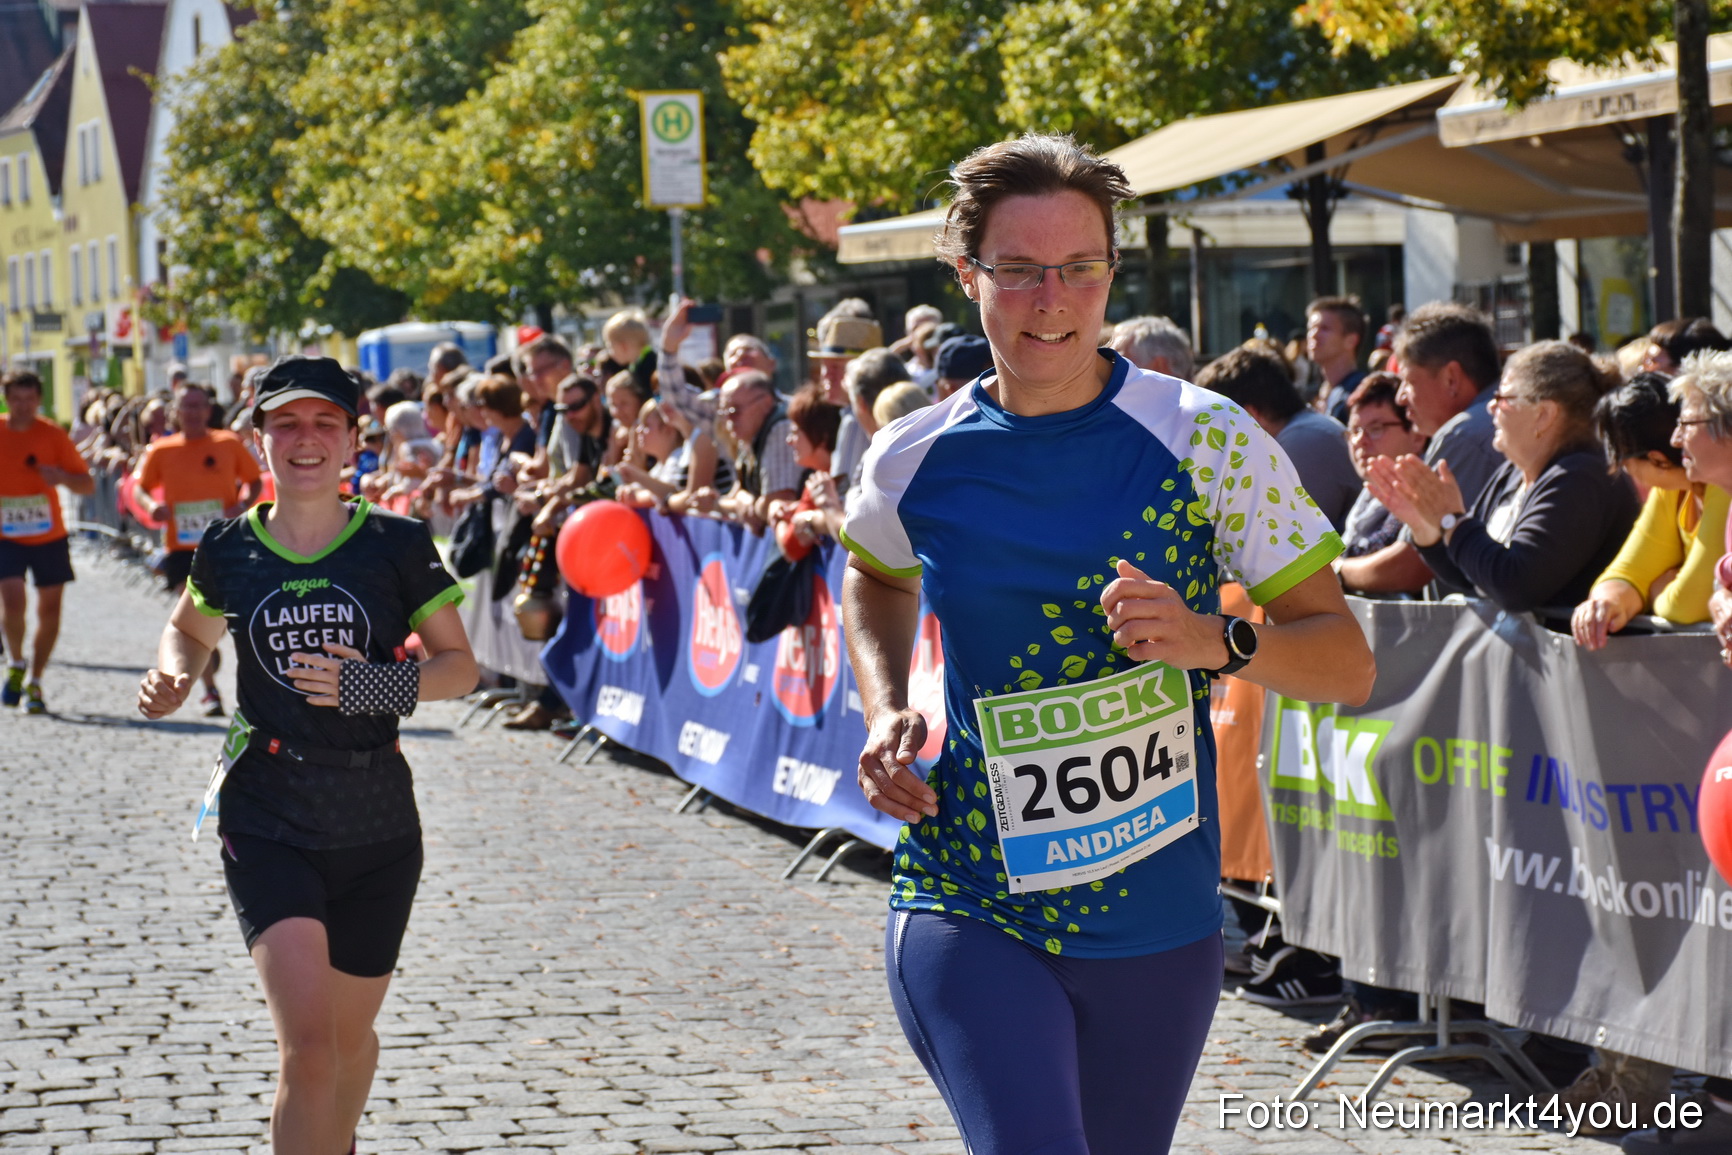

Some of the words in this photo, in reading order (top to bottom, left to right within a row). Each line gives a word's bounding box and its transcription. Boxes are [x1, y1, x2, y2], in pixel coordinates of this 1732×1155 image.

[282, 578, 331, 598] vegan
[264, 604, 353, 627] LAUFEN
[268, 629, 353, 651] GEGEN
[998, 675, 1166, 742] BOCK
[1176, 724, 1185, 735] D
[1013, 730, 1174, 822] 2604
[1045, 805, 1167, 865] ANDREA
